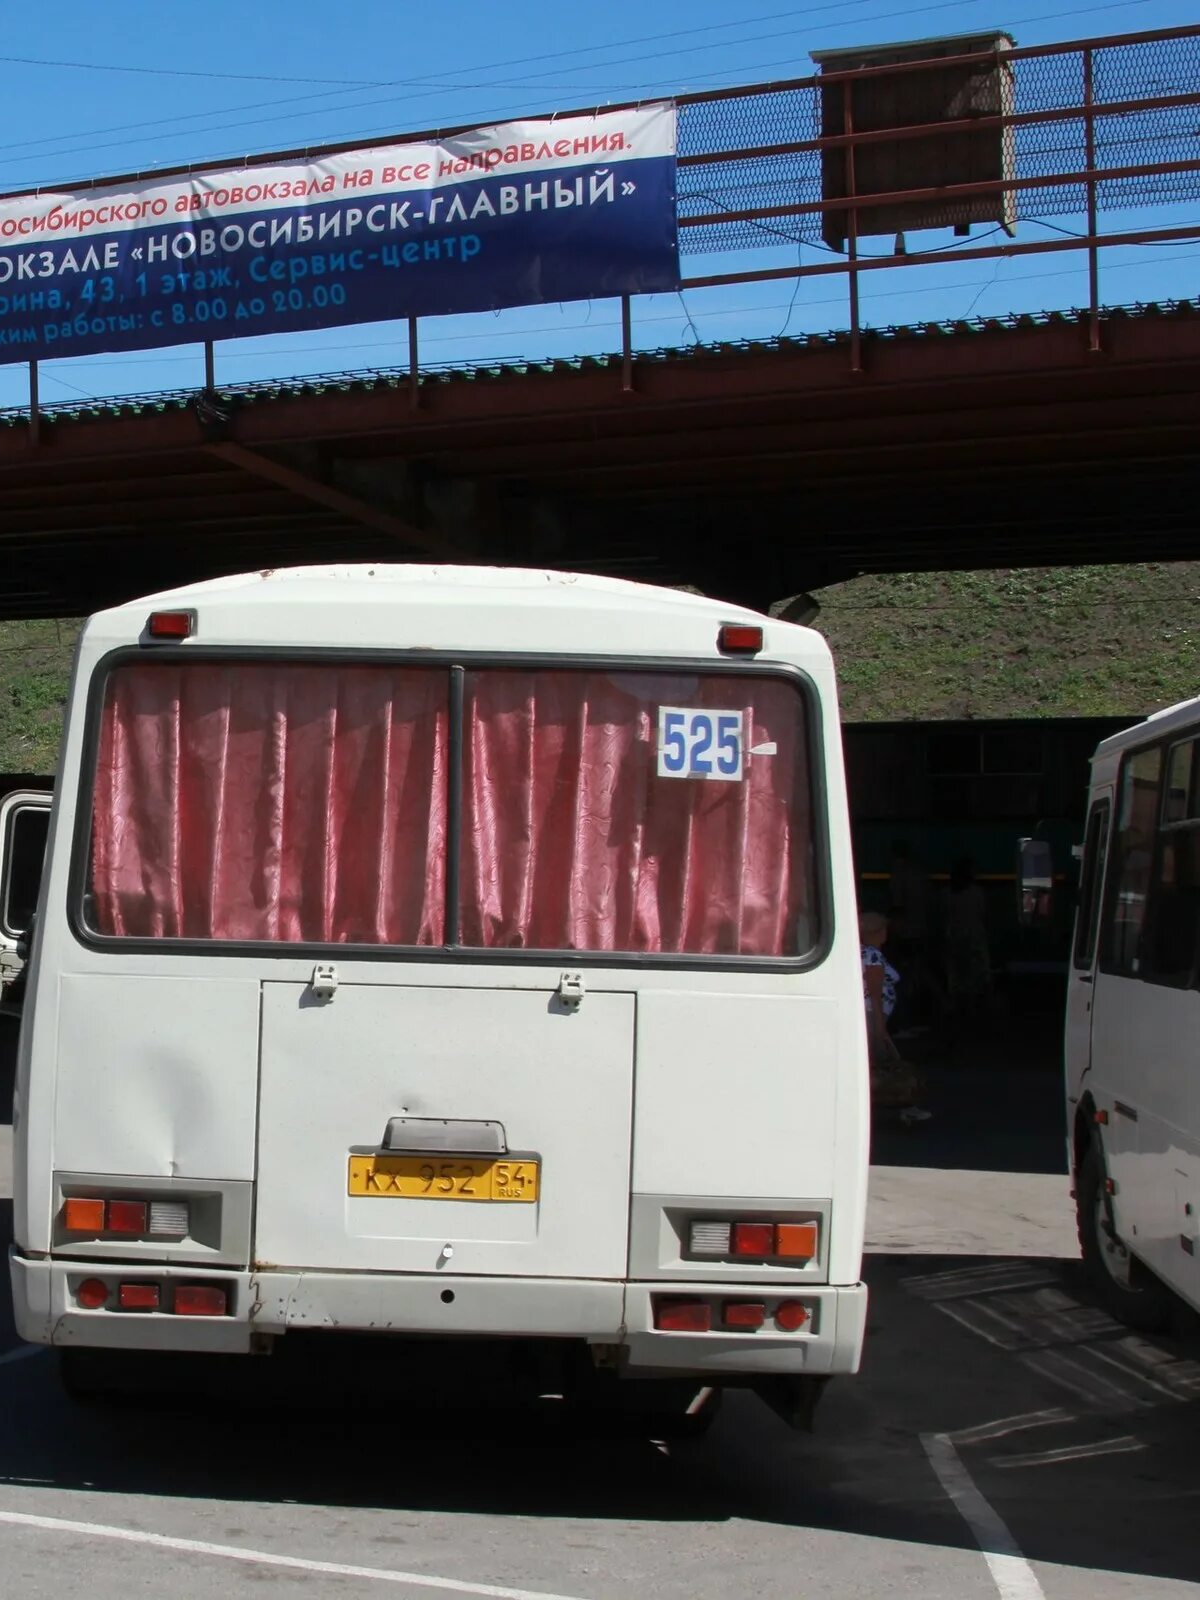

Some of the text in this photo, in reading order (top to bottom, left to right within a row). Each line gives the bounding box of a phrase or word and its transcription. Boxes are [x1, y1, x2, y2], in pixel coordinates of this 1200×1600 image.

[174, 175, 335, 212] автовокзала
[343, 168, 372, 188] на
[381, 163, 430, 183] все
[438, 132, 632, 178] направления.
[130, 168, 636, 264] «НОВОСИБИРСК-ГЛАВНЫЙ»
[81, 276, 124, 304] 43,
[135, 271, 147, 297] 1
[160, 265, 241, 295] этаж,
[250, 233, 482, 285] Сервис-центр
[43, 313, 144, 343] работы:
[151, 309, 164, 328] с
[171, 298, 228, 325] 8.00
[235, 297, 265, 320] до
[272, 284, 346, 312] 20.00
[664, 713, 739, 774] 525
[419, 1164, 475, 1195] 952
[496, 1164, 525, 1189] 54
[499, 1188, 522, 1198] RUS
